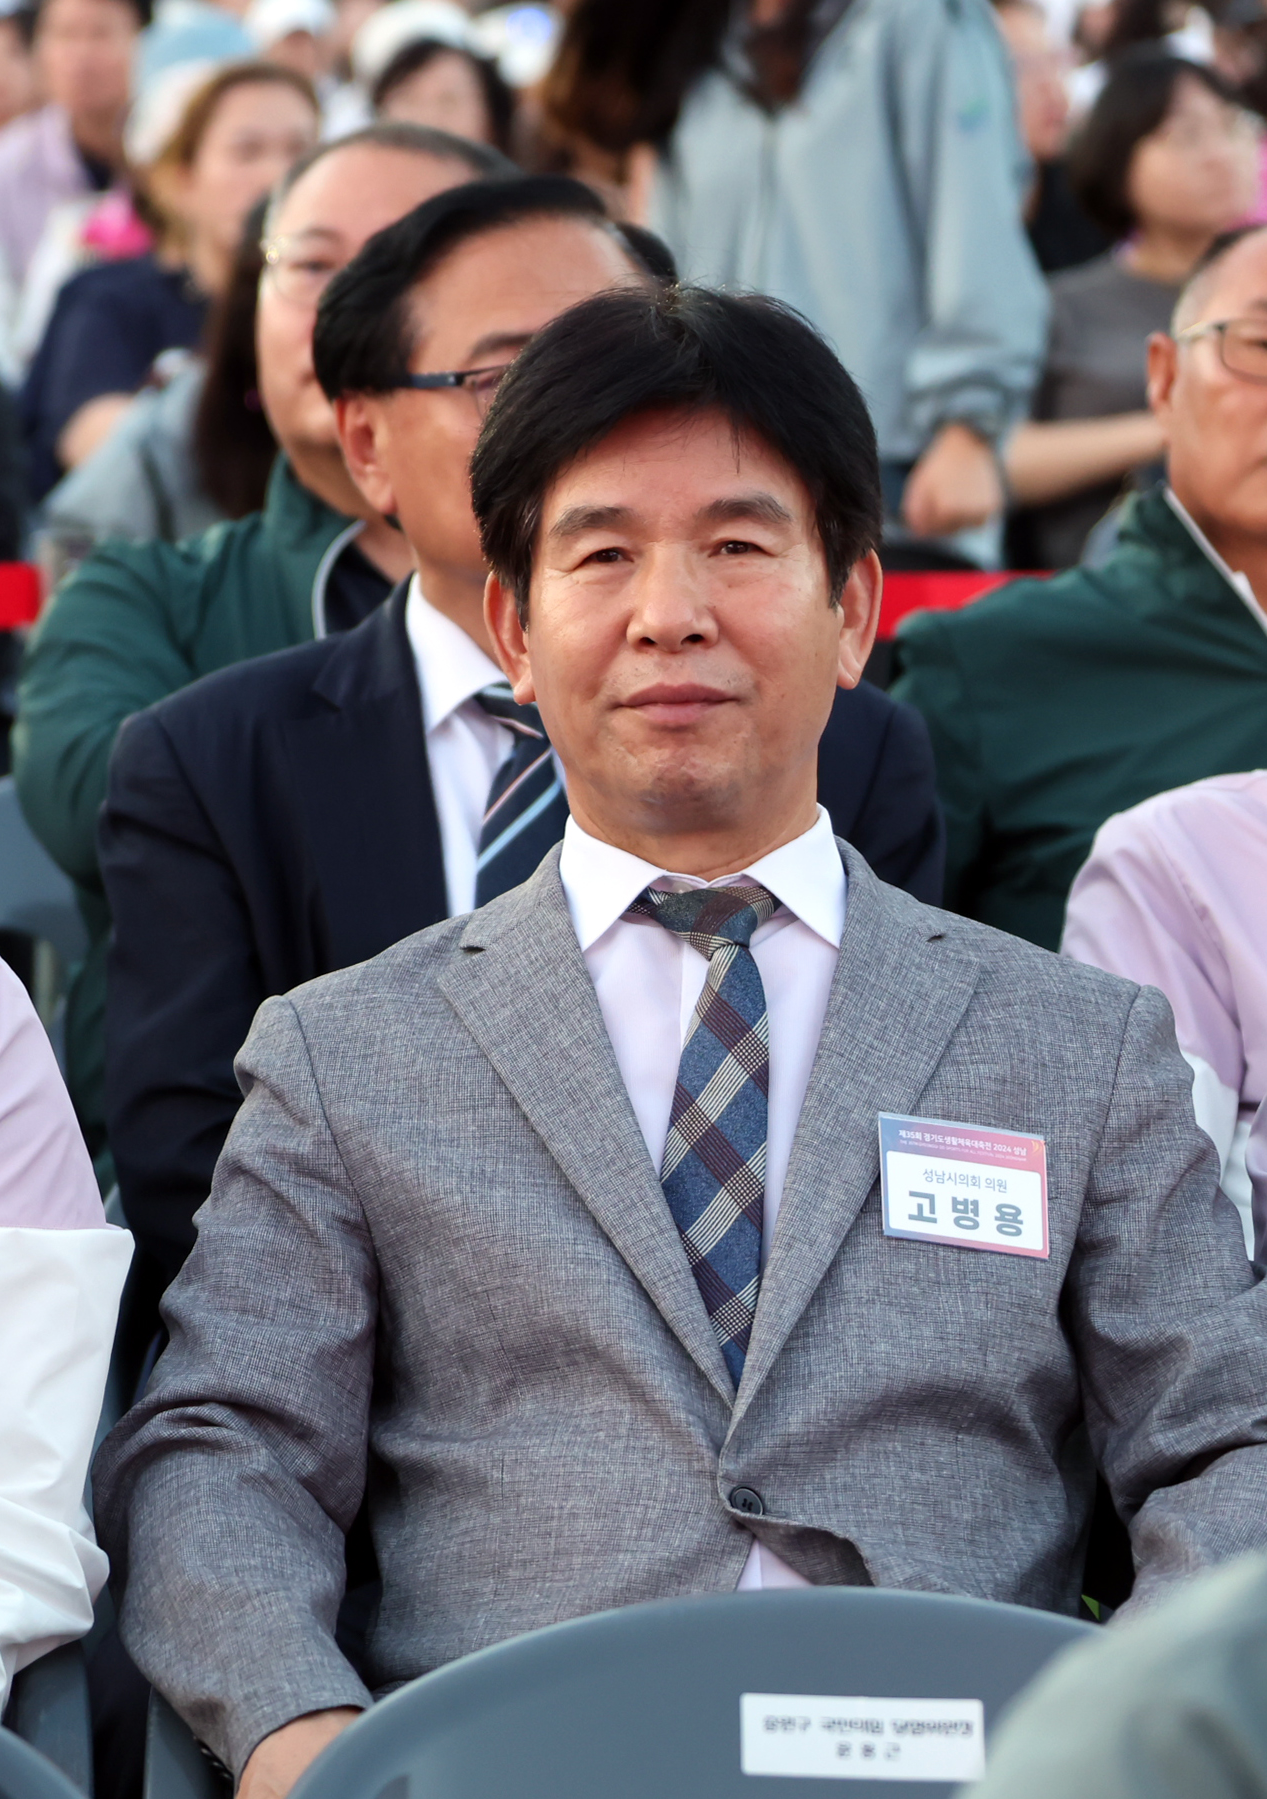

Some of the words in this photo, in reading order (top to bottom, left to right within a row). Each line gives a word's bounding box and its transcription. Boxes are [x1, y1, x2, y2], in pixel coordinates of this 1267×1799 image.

[898, 1129, 922, 1141] 제35회
[993, 1142, 1012, 1153] 2024
[1012, 1144, 1027, 1156] 성남
[922, 1168, 981, 1189] 성남시의회
[984, 1177, 1008, 1194] 의원
